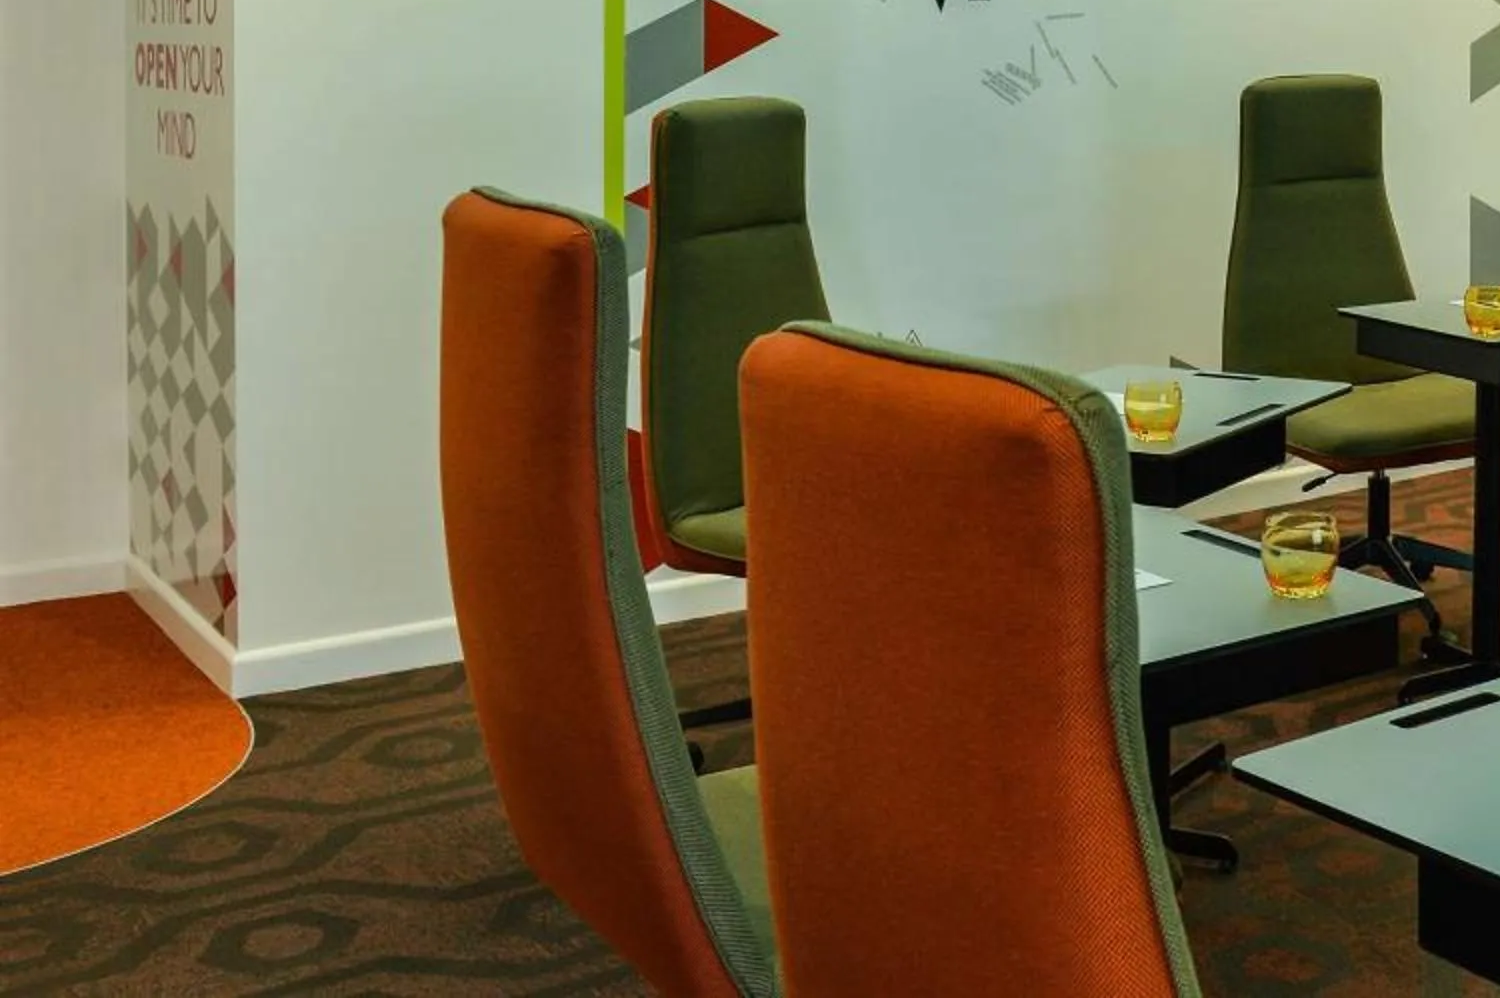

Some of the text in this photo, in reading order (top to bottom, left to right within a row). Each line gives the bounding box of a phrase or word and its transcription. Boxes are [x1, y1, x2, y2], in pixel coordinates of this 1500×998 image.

[135, 42, 225, 97] OPEN YOUR
[157, 107, 196, 160] MIND
